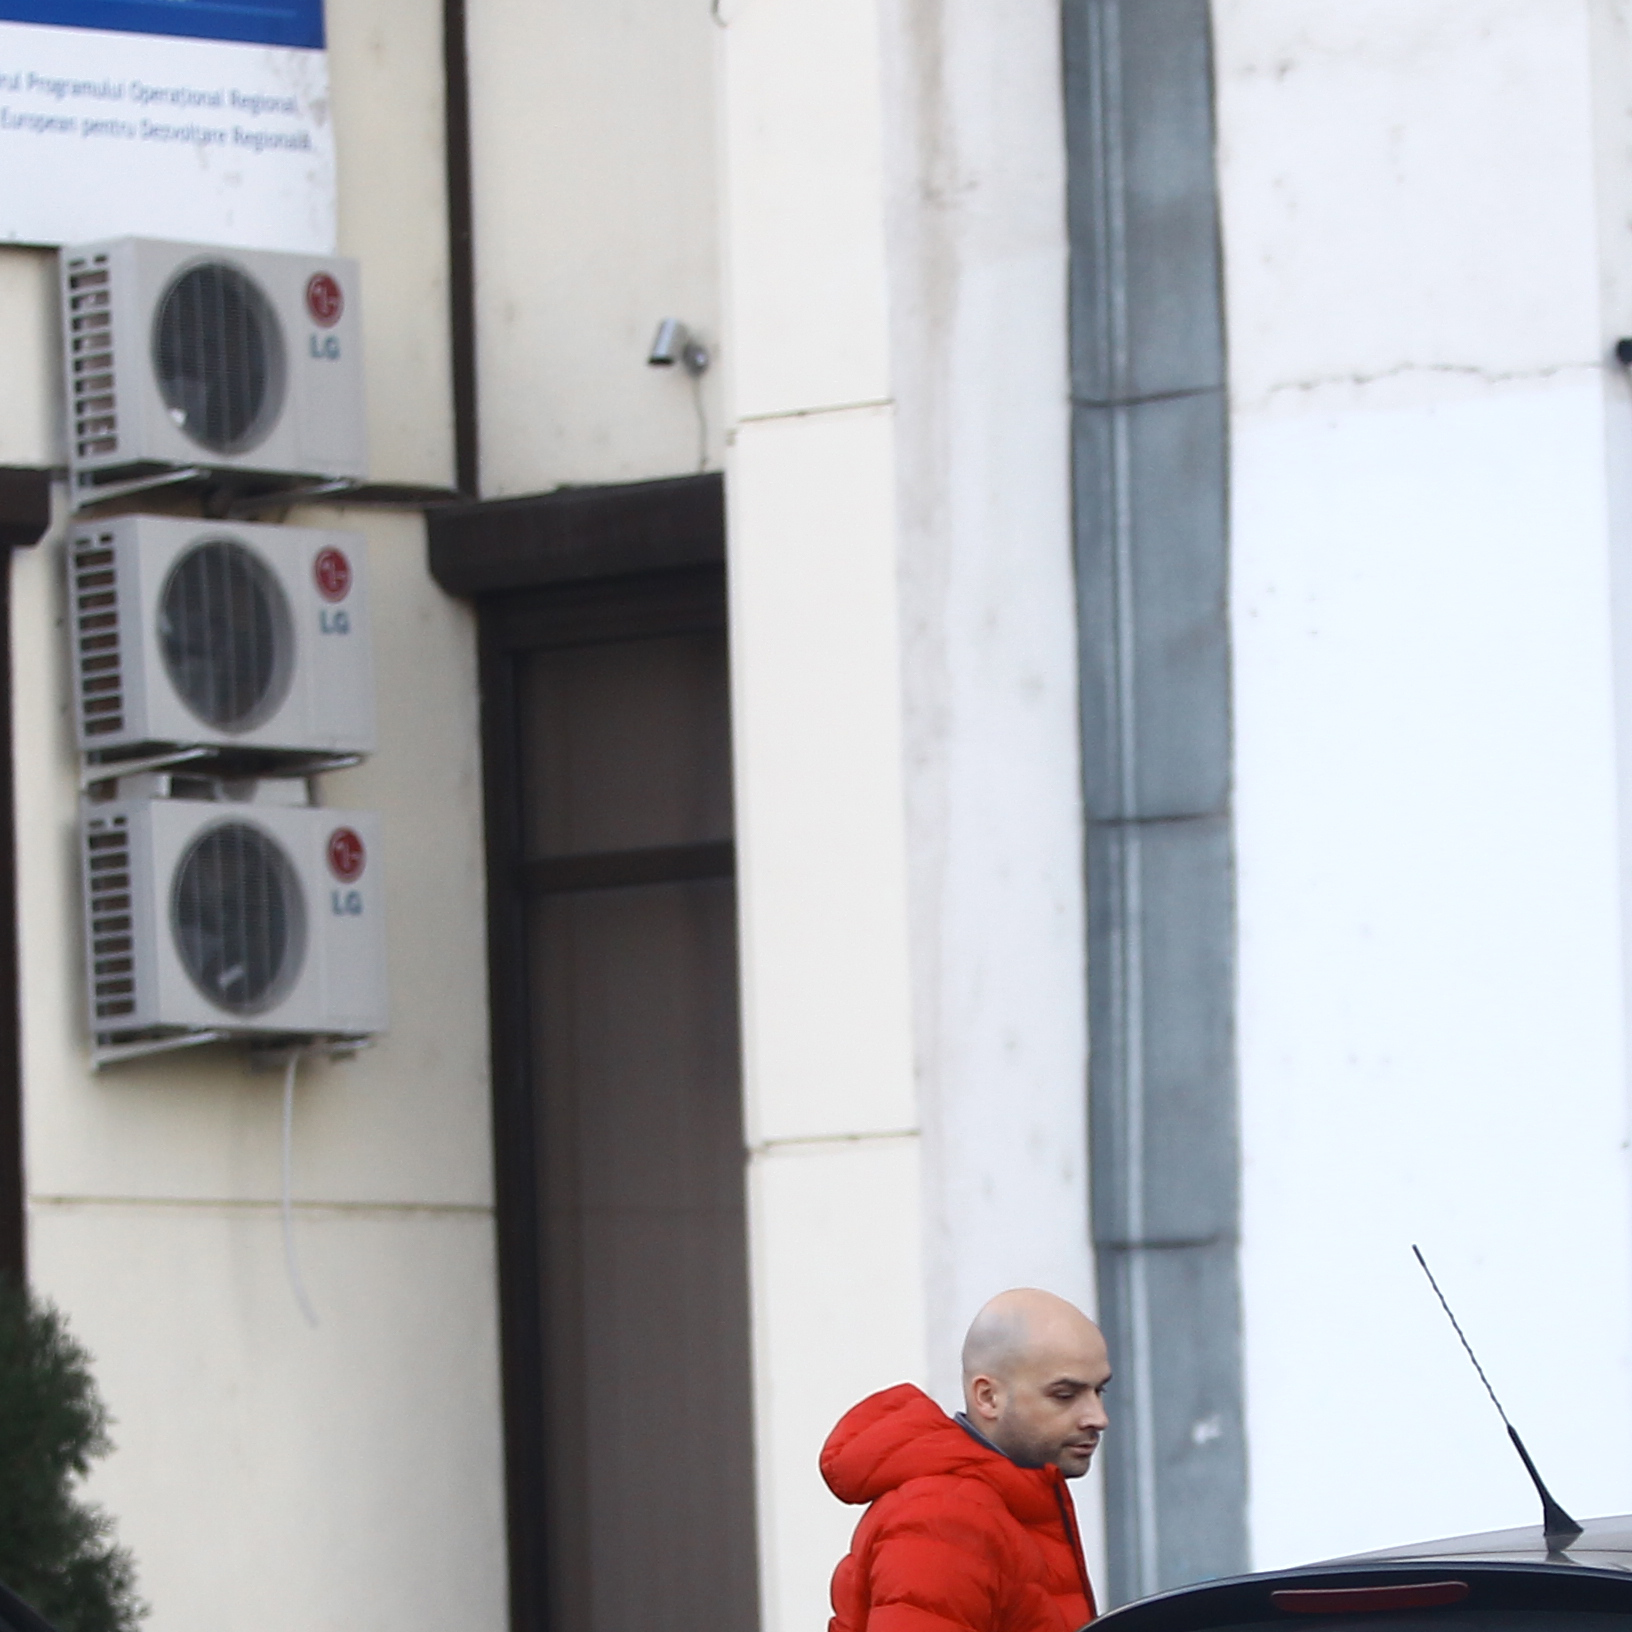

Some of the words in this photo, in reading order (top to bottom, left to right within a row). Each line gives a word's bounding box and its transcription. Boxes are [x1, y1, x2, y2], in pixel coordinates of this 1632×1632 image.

[27, 71, 125, 99] Programului
[0, 105, 74, 132] European
[81, 117, 137, 140] pentru
[139, 117, 227, 145] Dezvoltare
[310, 333, 342, 361] LG
[319, 610, 351, 635] LG
[331, 890, 364, 916] LG
